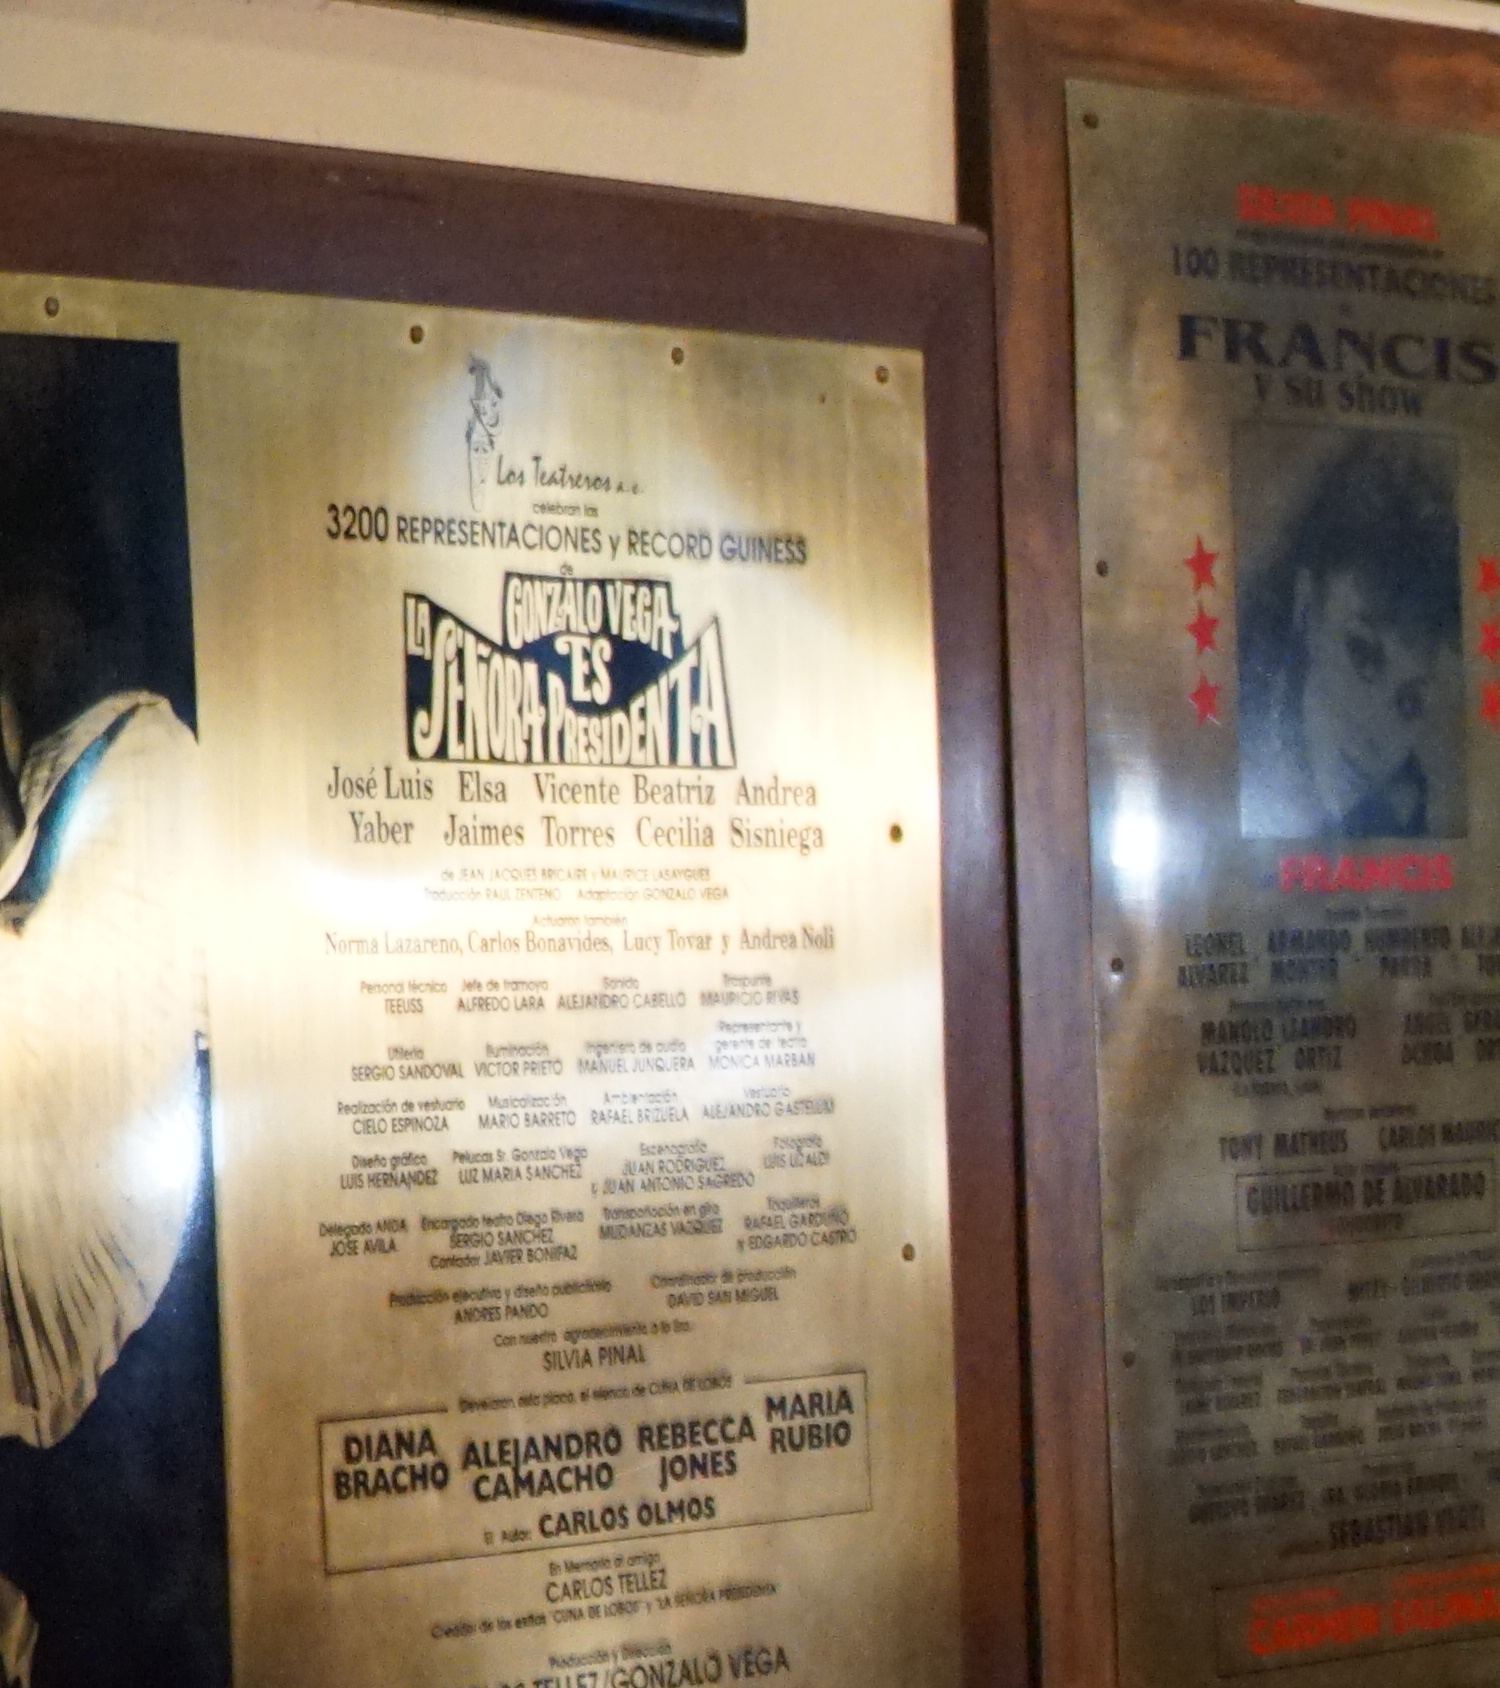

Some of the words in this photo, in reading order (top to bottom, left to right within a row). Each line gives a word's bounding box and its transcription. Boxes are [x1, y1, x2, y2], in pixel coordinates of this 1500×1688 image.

[1172, 244, 1219, 279] 100
[1228, 250, 1498, 306] REPRESENTACIONES
[1177, 314, 1500, 385] FRANCIS
[496, 454, 525, 486] Los
[531, 454, 612, 492] Teatreros
[532, 503, 581, 517] celebran
[326, 503, 389, 542] 3200
[396, 515, 602, 554] REPRESENTACIONES
[609, 534, 621, 560] y
[627, 527, 713, 562] RECORD
[719, 530, 808, 566] GUINESS
[406, 596, 431, 660] LA
[507, 577, 603, 650] GONZALO
[605, 579, 680, 659] VEGA
[554, 632, 612, 705] ES
[546, 614, 736, 766] PRESIDENTA
[326, 765, 378, 799] José
[384, 766, 434, 800] Luis
[458, 770, 508, 803] Elsa
[534, 772, 620, 805] Vicente
[633, 773, 716, 806] Beatriz
[736, 772, 818, 806] Andrea
[349, 810, 414, 845] Yaber
[443, 813, 525, 847] Jaimes
[541, 815, 616, 847] Torres
[636, 815, 716, 848] Cecilia
[729, 816, 825, 857] Sisniega
[1278, 853, 1454, 893] FRANCIS
[324, 930, 379, 956] Norma
[384, 929, 464, 957] Lazareno,
[467, 928, 520, 954] Carlos
[525, 928, 614, 955] Bonavides,
[623, 928, 661, 957] Lucy
[667, 926, 713, 952] Tovar
[721, 933, 730, 956] y
[739, 926, 798, 952] Andrea
[801, 923, 836, 951] Noli
[456, 995, 511, 1012] ALFREDO
[514, 994, 546, 1011] LARA
[557, 991, 630, 1011] ALEJANDRO
[632, 990, 687, 1009] CABELLO
[351, 1062, 395, 1082] SERGIO
[399, 1060, 464, 1081] SANDOVAL
[474, 1060, 519, 1078] VICTOR
[523, 1059, 563, 1076] PRIETO
[352, 1117, 387, 1136] CIELO
[391, 1114, 449, 1134] ESPINOZA
[478, 1112, 519, 1130] MARIO
[524, 1109, 578, 1128] BARRETO
[590, 1107, 633, 1125] RAFAEL
[340, 1172, 364, 1190] LUIS
[367, 1168, 439, 1190] HERNANDEZ
[482, 1165, 522, 1183] MARIA
[543, 1348, 592, 1372] SILVIA
[599, 1344, 646, 1368] PINAL
[343, 1427, 437, 1466] DIANA
[462, 1425, 623, 1472] ALEJANDRO
[637, 1414, 757, 1453] REBECCA
[765, 1386, 855, 1422] MARIA
[334, 1461, 449, 1502] BRACHO
[473, 1461, 614, 1503] CAMACHO
[658, 1448, 738, 1492] JONES
[769, 1420, 852, 1454] RUBIO
[538, 1504, 629, 1539] CARLOS
[636, 1496, 717, 1527] OLMOS
[545, 1576, 614, 1603] CARLOS
[618, 1567, 668, 1595] TELLEZ
[728, 1645, 791, 1682] VEGA
